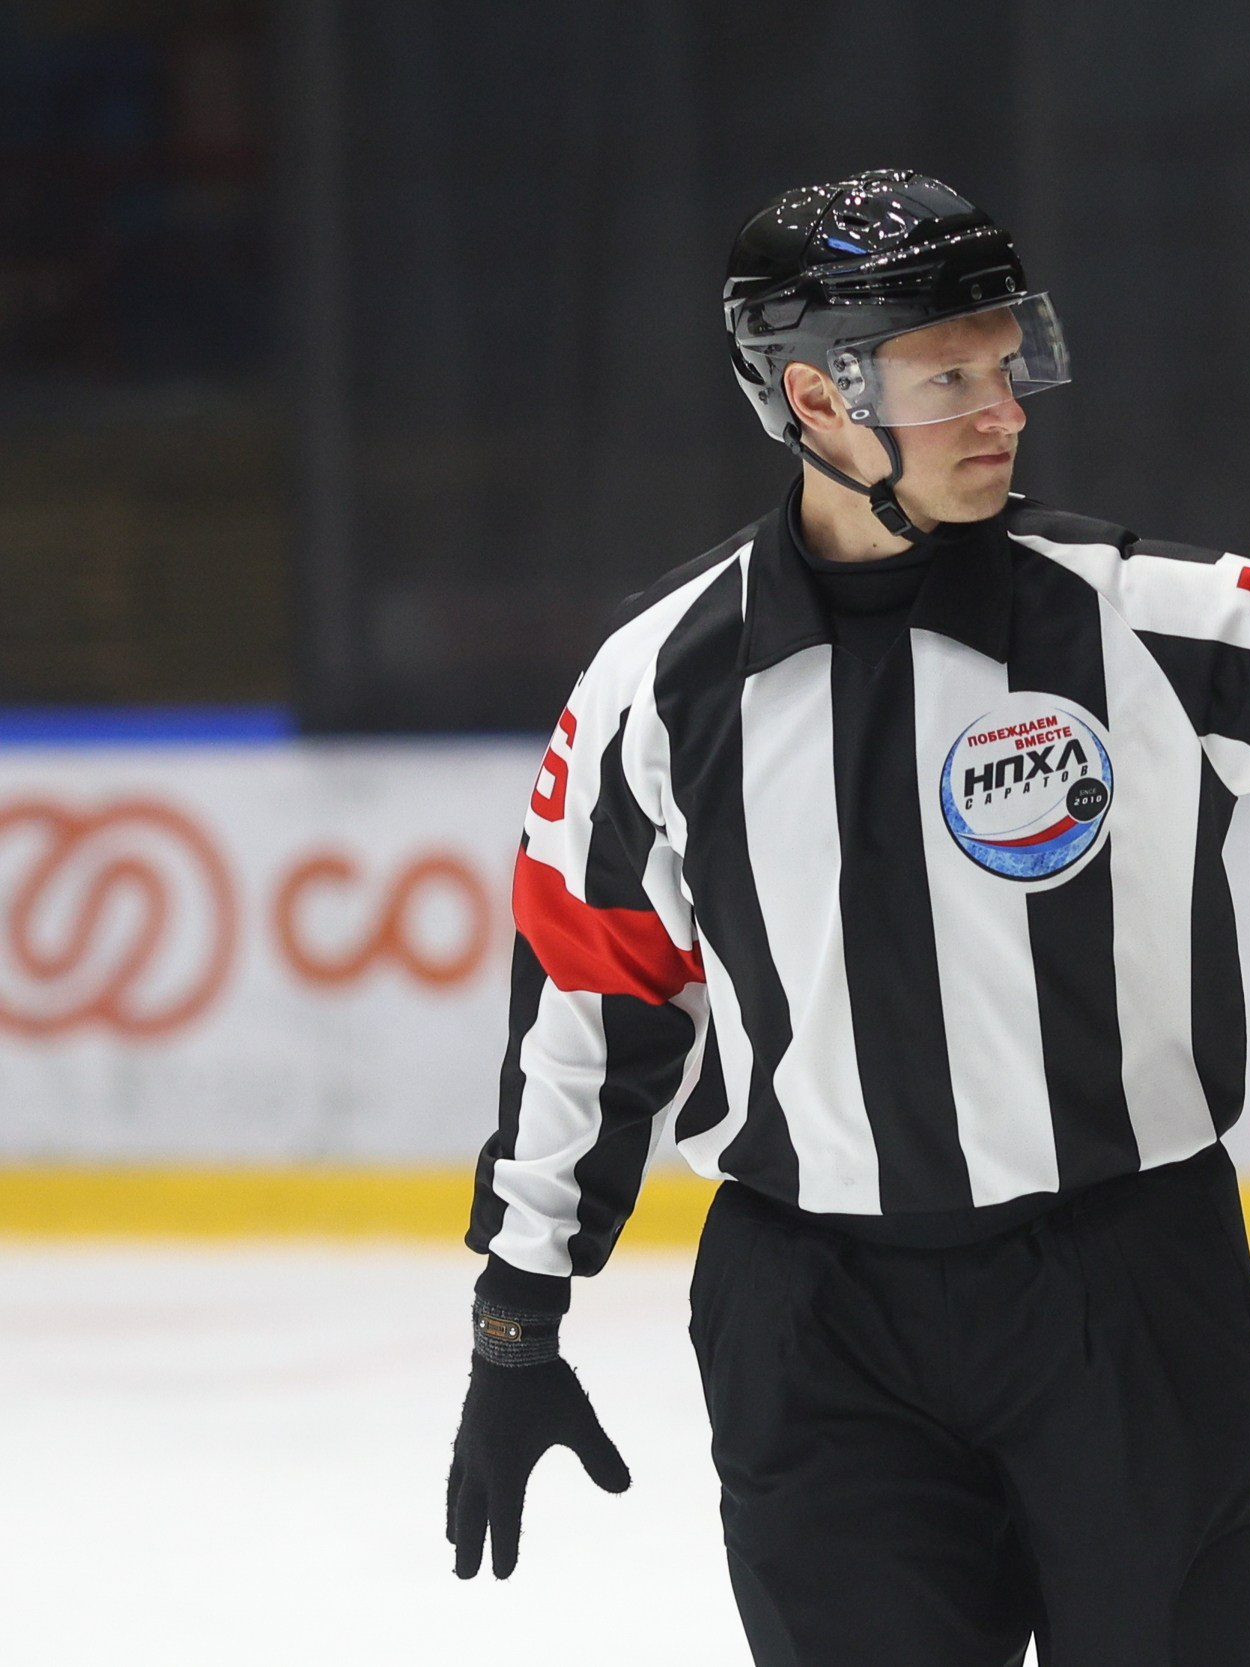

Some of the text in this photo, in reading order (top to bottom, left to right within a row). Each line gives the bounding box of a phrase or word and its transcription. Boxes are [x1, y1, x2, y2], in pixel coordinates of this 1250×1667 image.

[967, 715, 1058, 747] ПОБЕЖДАЕМ
[1015, 726, 1073, 751] ВМЕСТЕ
[964, 739, 1088, 798] НПХЛ
[965, 765, 1088, 810] САРАТОВ
[1073, 795, 1102, 806] 2010
